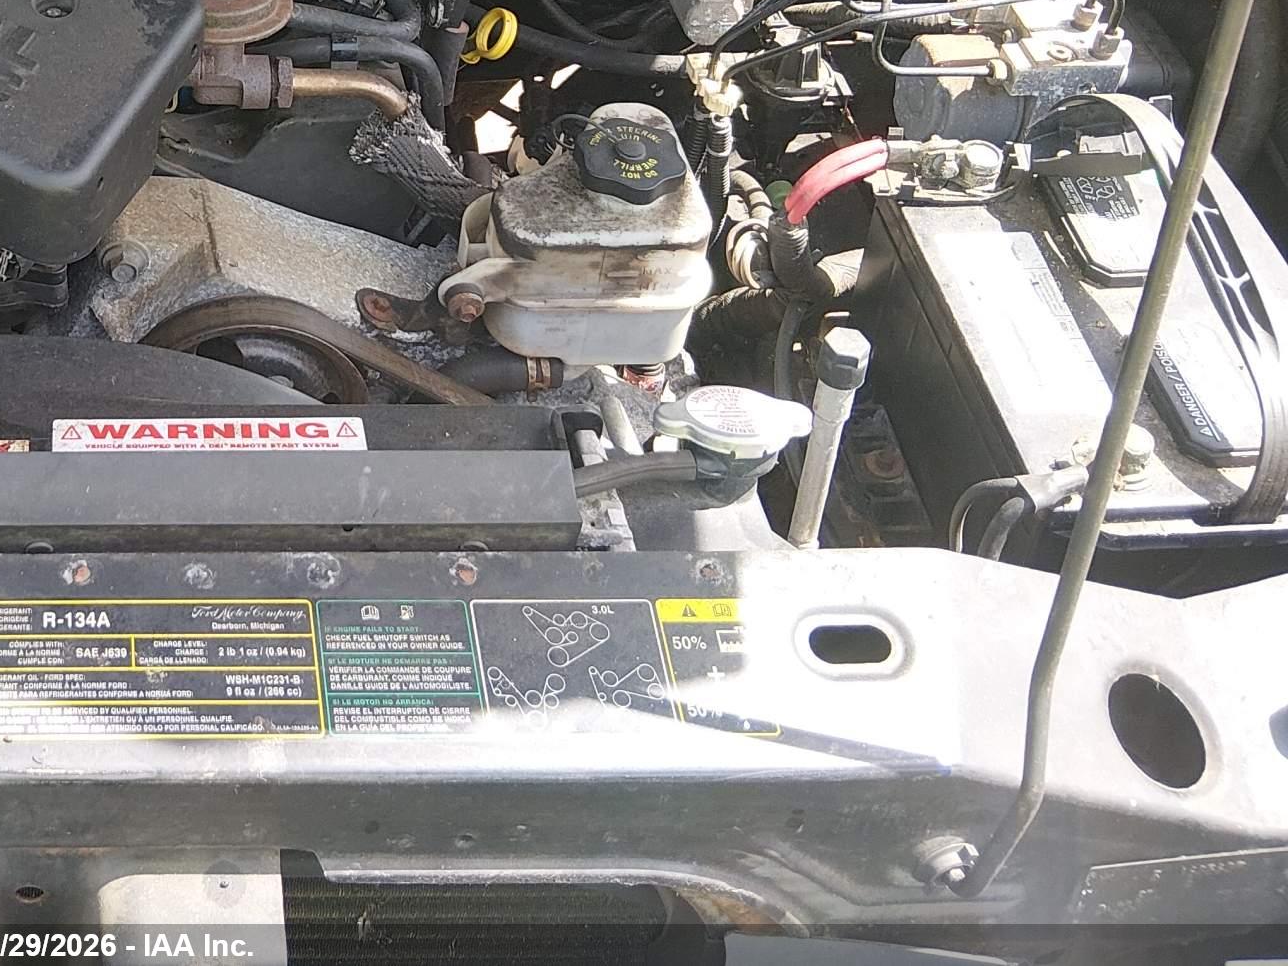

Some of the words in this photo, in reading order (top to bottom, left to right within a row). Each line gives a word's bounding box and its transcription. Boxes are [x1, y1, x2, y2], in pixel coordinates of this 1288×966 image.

[616, 126, 662, 144] STEERING
[614, 158, 658, 170] OVERFILL
[644, 170, 658, 178] DO
[642, 267, 672, 275] MAX
[1152, 342, 1178, 374] POISO
[1174, 383, 1206, 426] DANGER
[87, 423, 330, 440] WARNING
[85, 442, 123, 450] VEHICLE
[126, 442, 171, 450] EQUIPPED
[174, 442, 198, 450] WITH
[200, 442, 206, 450] A
[230, 442, 266, 450] REMOTE
[270, 442, 300, 450] START
[302, 442, 340, 450] SYSTEM
[192, 606, 218, 620] Ford
[216, 606, 250, 622] Motor
[591, 605, 615, 615] 3.0L
[42, 611, 111, 629] R-134A
[212, 622, 249, 631] Dearborn,
[250, 622, 285, 632] Michigan
[8, 640, 44, 648] COMPLIES
[153, 640, 182, 648] CHARGE
[672, 636, 708, 650] 50%
[74, 648, 98, 658] SAE
[102, 648, 128, 658] J639
[175, 648, 204, 656] CHARGE
[218, 647, 225, 656] 2
[226, 647, 236, 656] lb
[238, 647, 244, 656] 1
[246, 648, 258, 656] oz
[260, 647, 264, 656] /
[265, 646, 288, 658] (0.94
[290, 646, 306, 658] kg)
[139, 656, 163, 664] CARGA
[164, 656, 174, 664] DE
[364, 666, 374, 674] LA
[376, 666, 420, 674] COMMANDE
[422, 666, 432, 674] DE
[434, 666, 472, 674] COUPURE
[27, 674, 39, 682] OIL
[44, 674, 64, 682] FORD
[330, 674, 340, 682] DE
[392, 674, 420, 682] COMME
[23, 682, 62, 690] CONFORME
[71, 682, 80, 690] LA
[81, 682, 106, 690] NORME
[108, 682, 128, 690] FORD
[352, 682, 364, 690] LE
[364, 682, 388, 690] GUIDE
[390, 682, 400, 690] DE
[40, 690, 97, 698] REFRIGERANTES
[98, 690, 137, 698] CONFORME
[139, 690, 144, 698] A
[226, 687, 232, 696] 9
[234, 687, 242, 696] fl
[244, 688, 256, 696] oz
[258, 687, 262, 696] /
[264, 686, 284, 697] (266
[287, 686, 302, 697] cc)
[164, 724, 179, 732] POR
[181, 724, 219, 732] PERSONAL
[336, 724, 346, 732] EN
[348, 724, 358, 732] LA
[380, 724, 395, 732] DEL
